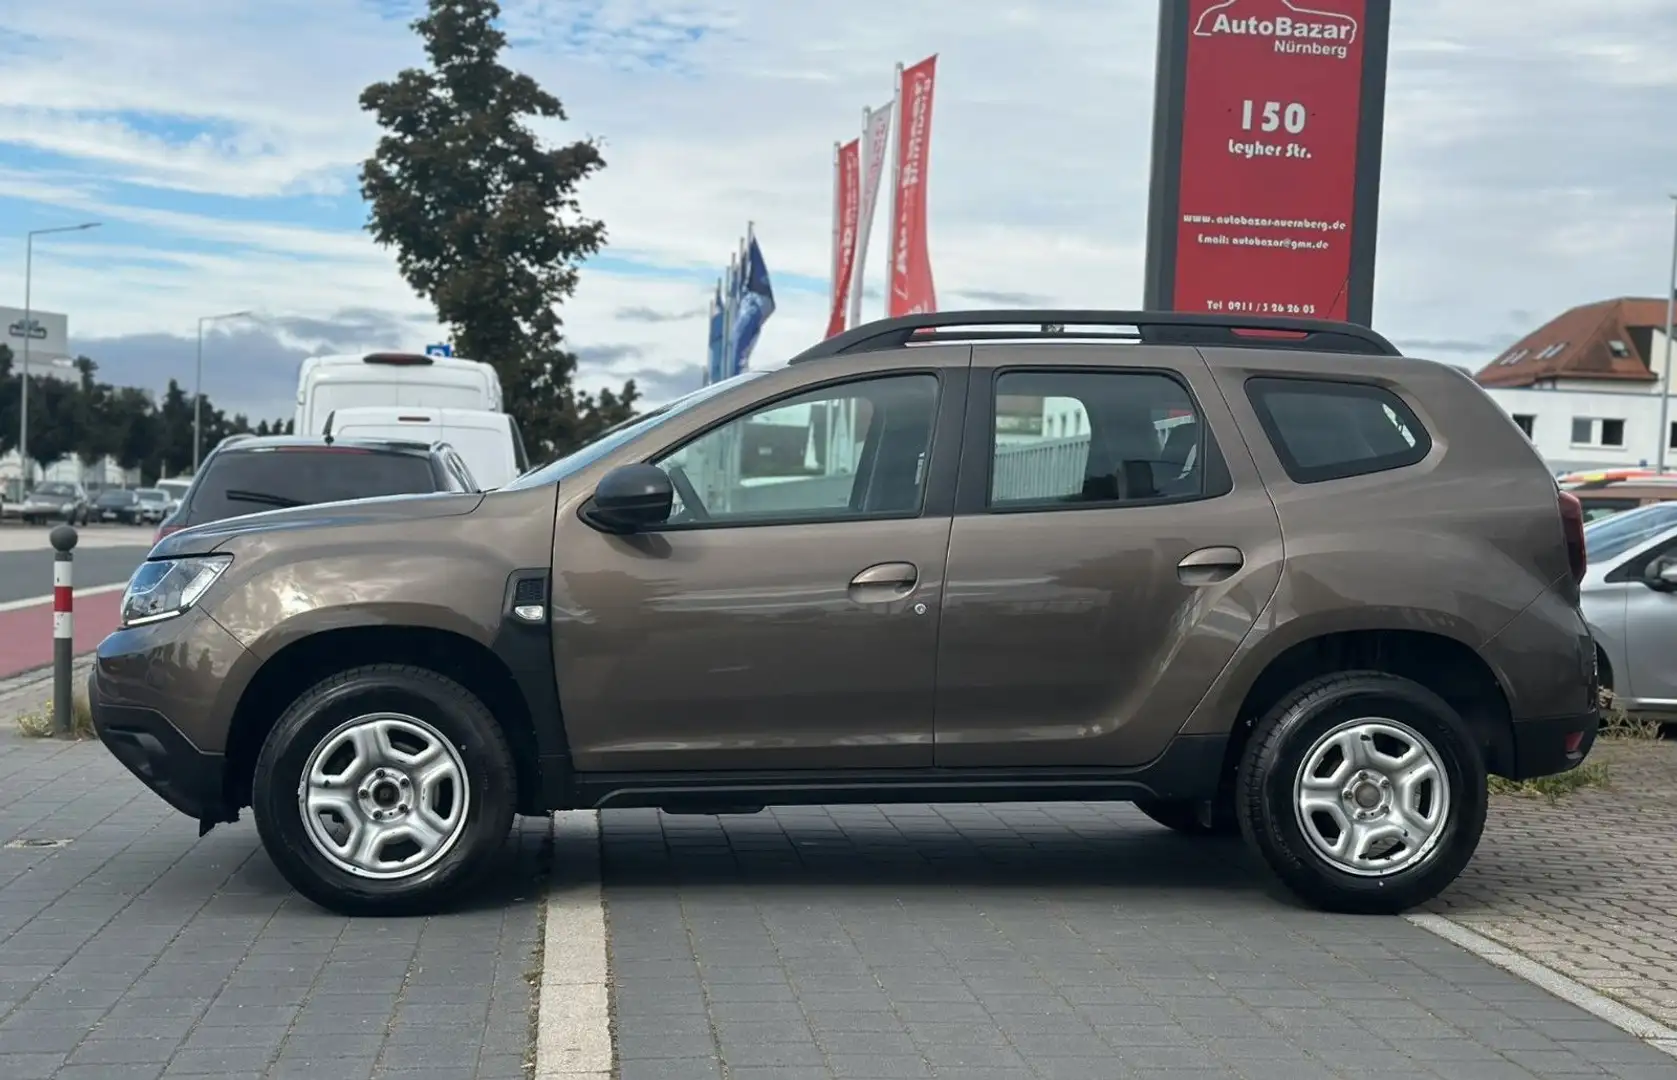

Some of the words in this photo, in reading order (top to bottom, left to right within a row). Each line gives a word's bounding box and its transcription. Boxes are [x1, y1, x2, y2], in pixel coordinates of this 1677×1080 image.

[1212, 14, 1350, 39] AutoBazar
[1274, 40, 1347, 59] Nürnberg
[1228, 139, 1282, 159] Leyher
[1285, 143, 1312, 158] Str.
[1197, 233, 1230, 245] Email:
[1206, 300, 1223, 311] Tel
